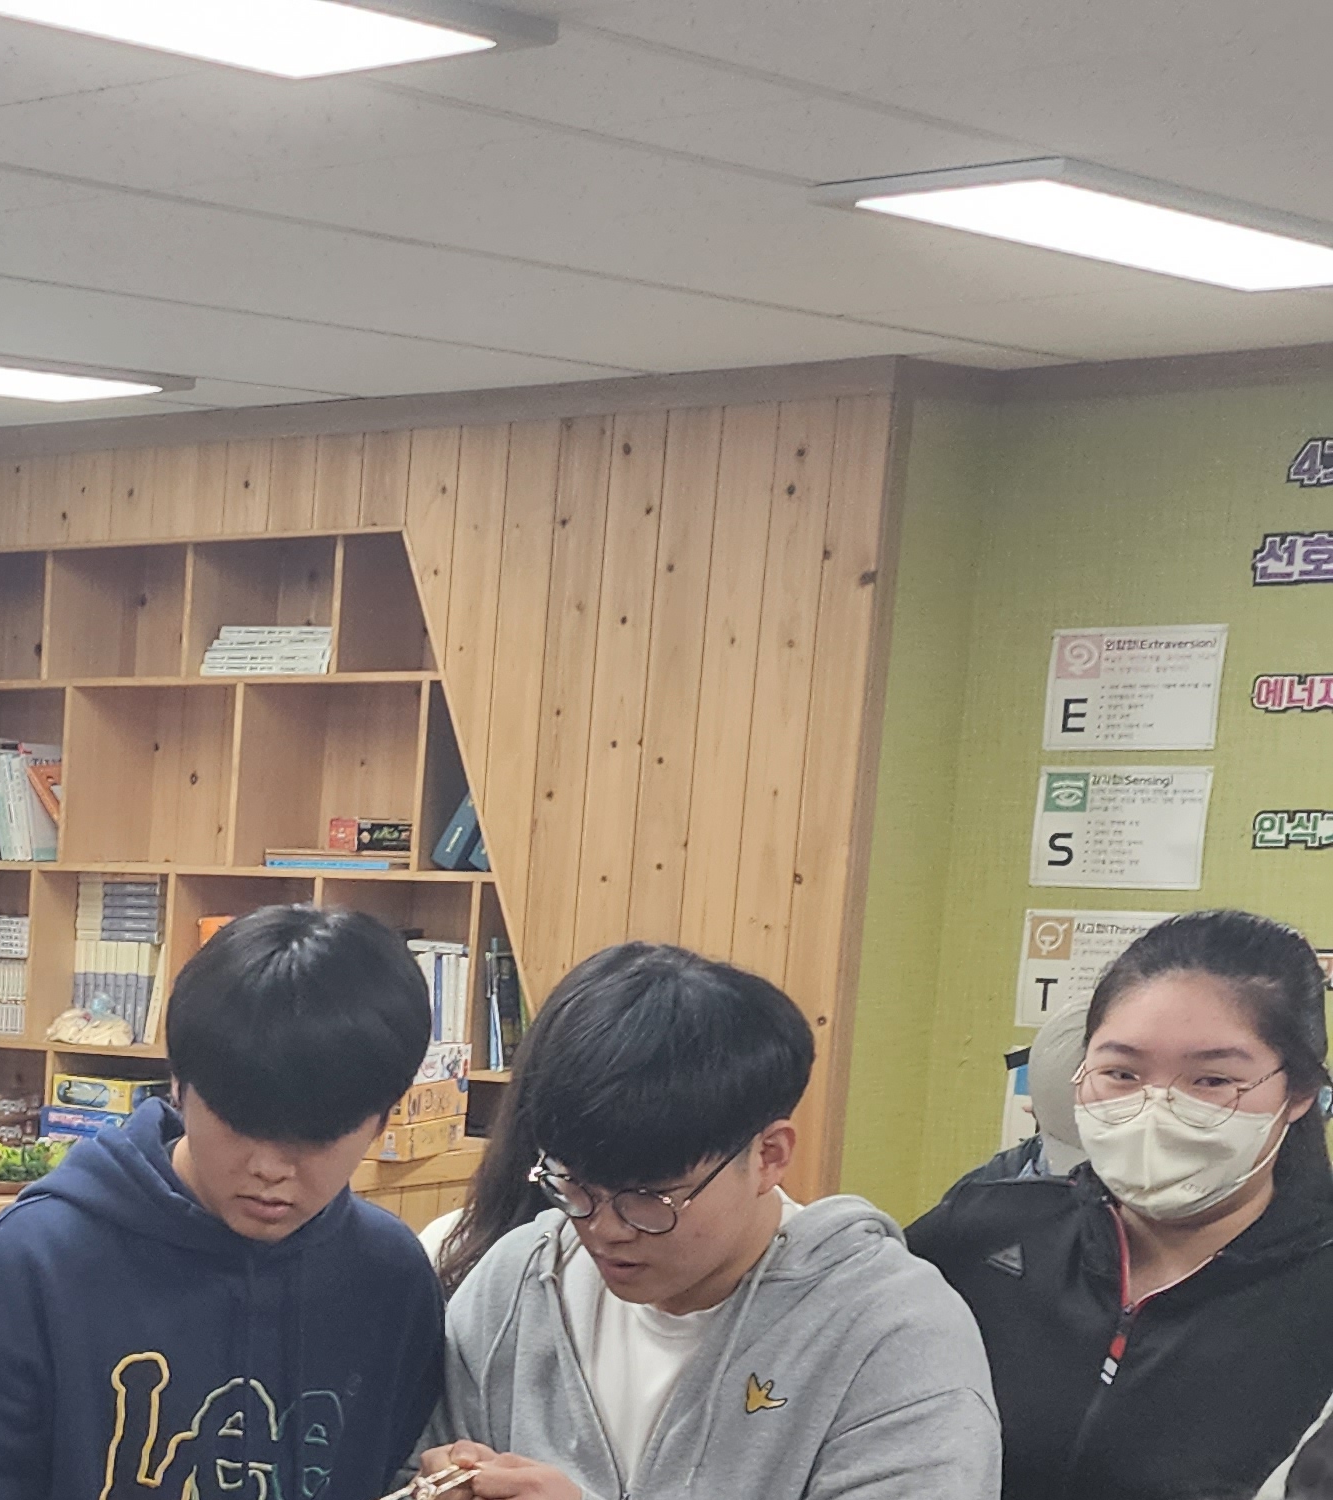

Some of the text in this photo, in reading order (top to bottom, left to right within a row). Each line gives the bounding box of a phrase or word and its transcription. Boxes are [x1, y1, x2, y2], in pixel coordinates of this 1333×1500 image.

[1061, 698, 1088, 733] E
[1047, 832, 1074, 866] S
[1035, 978, 1058, 1011] T
